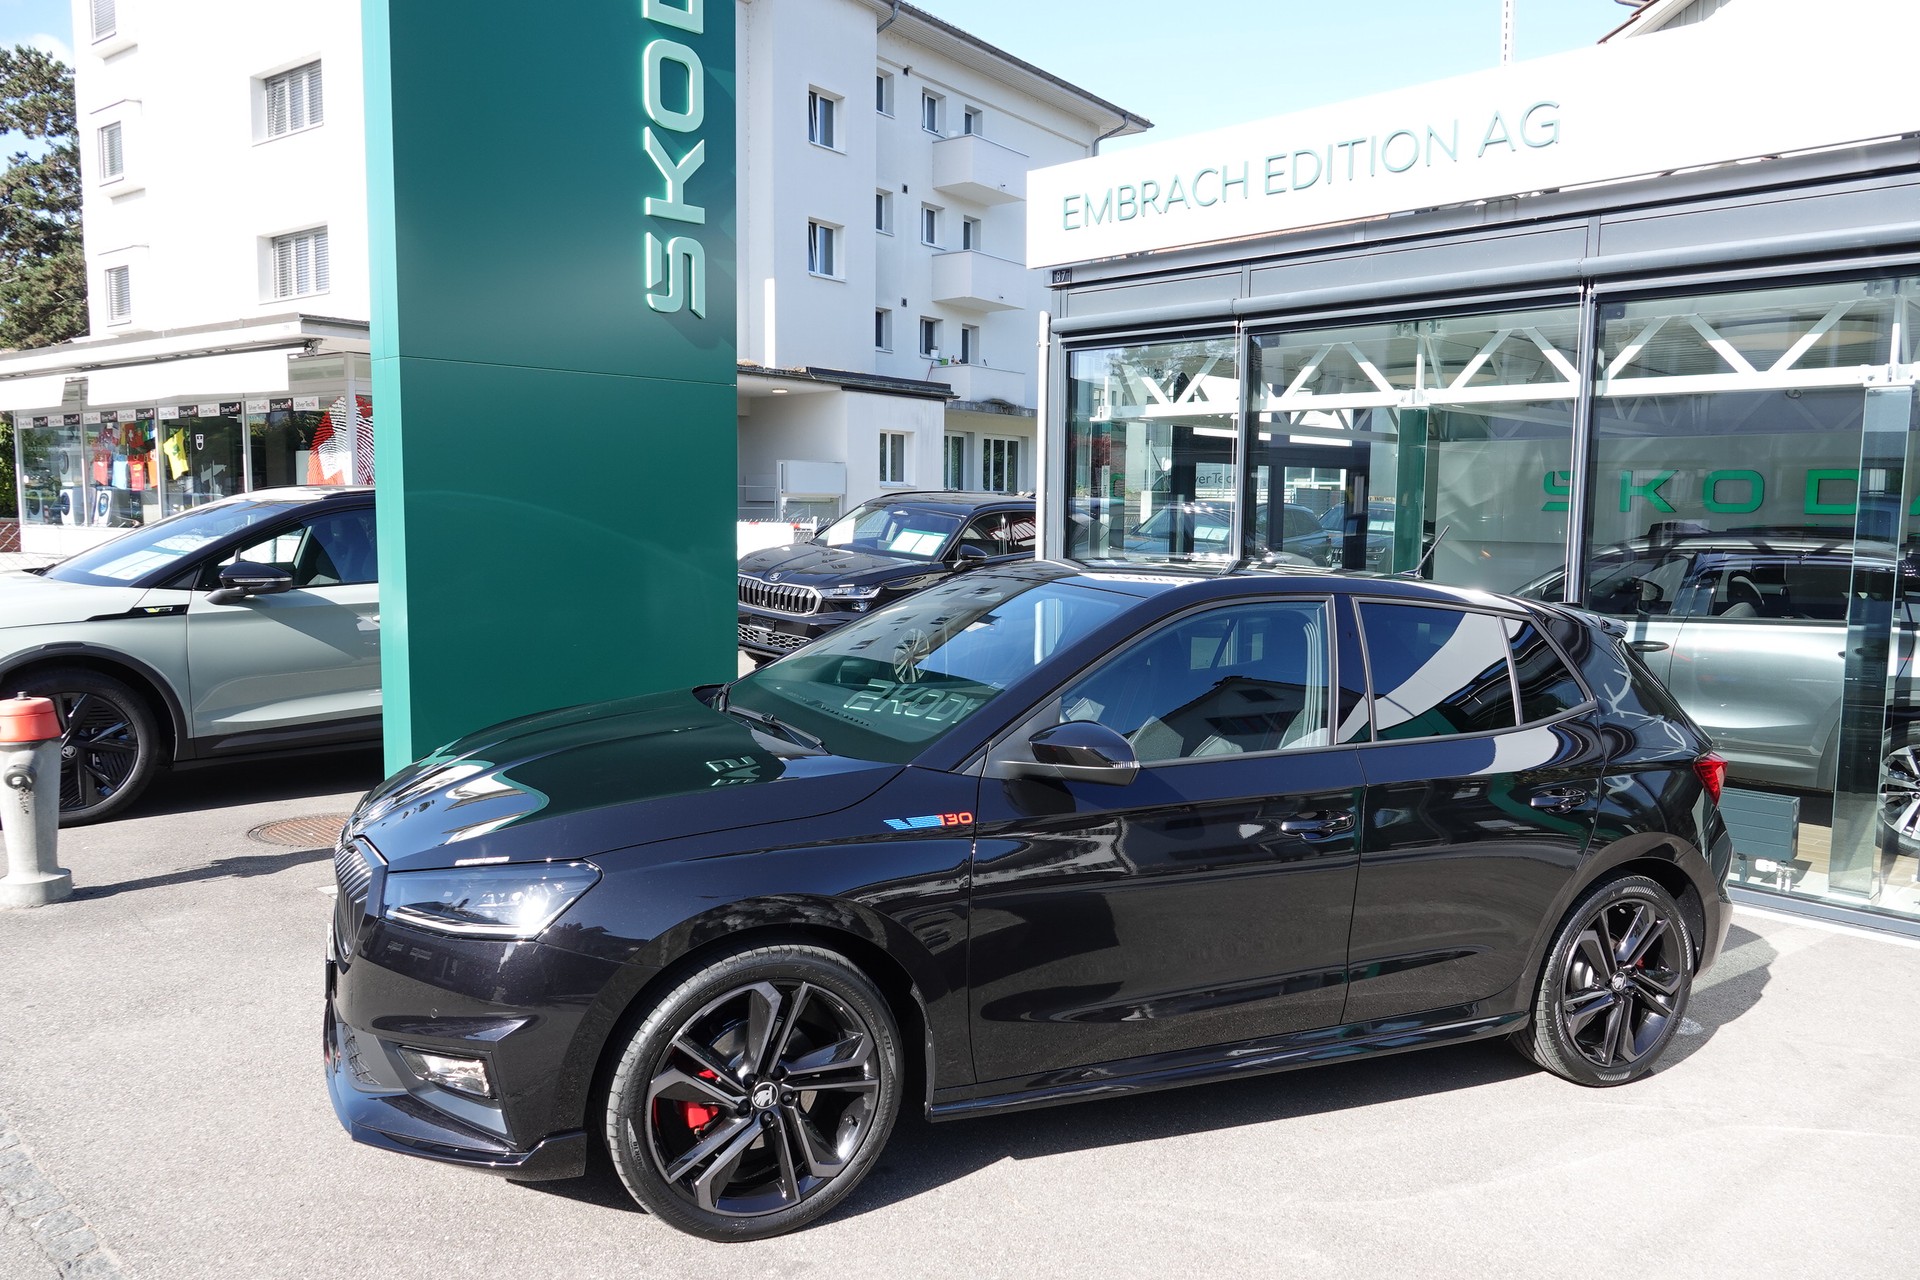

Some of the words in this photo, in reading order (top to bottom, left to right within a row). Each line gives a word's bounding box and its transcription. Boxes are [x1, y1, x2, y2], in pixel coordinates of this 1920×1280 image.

[1063, 160, 1249, 230] EMBRACH
[1264, 119, 1459, 196] EDITION
[1477, 100, 1561, 158] AG
[1056, 270, 1067, 283] 87
[936, 812, 973, 827] 130
